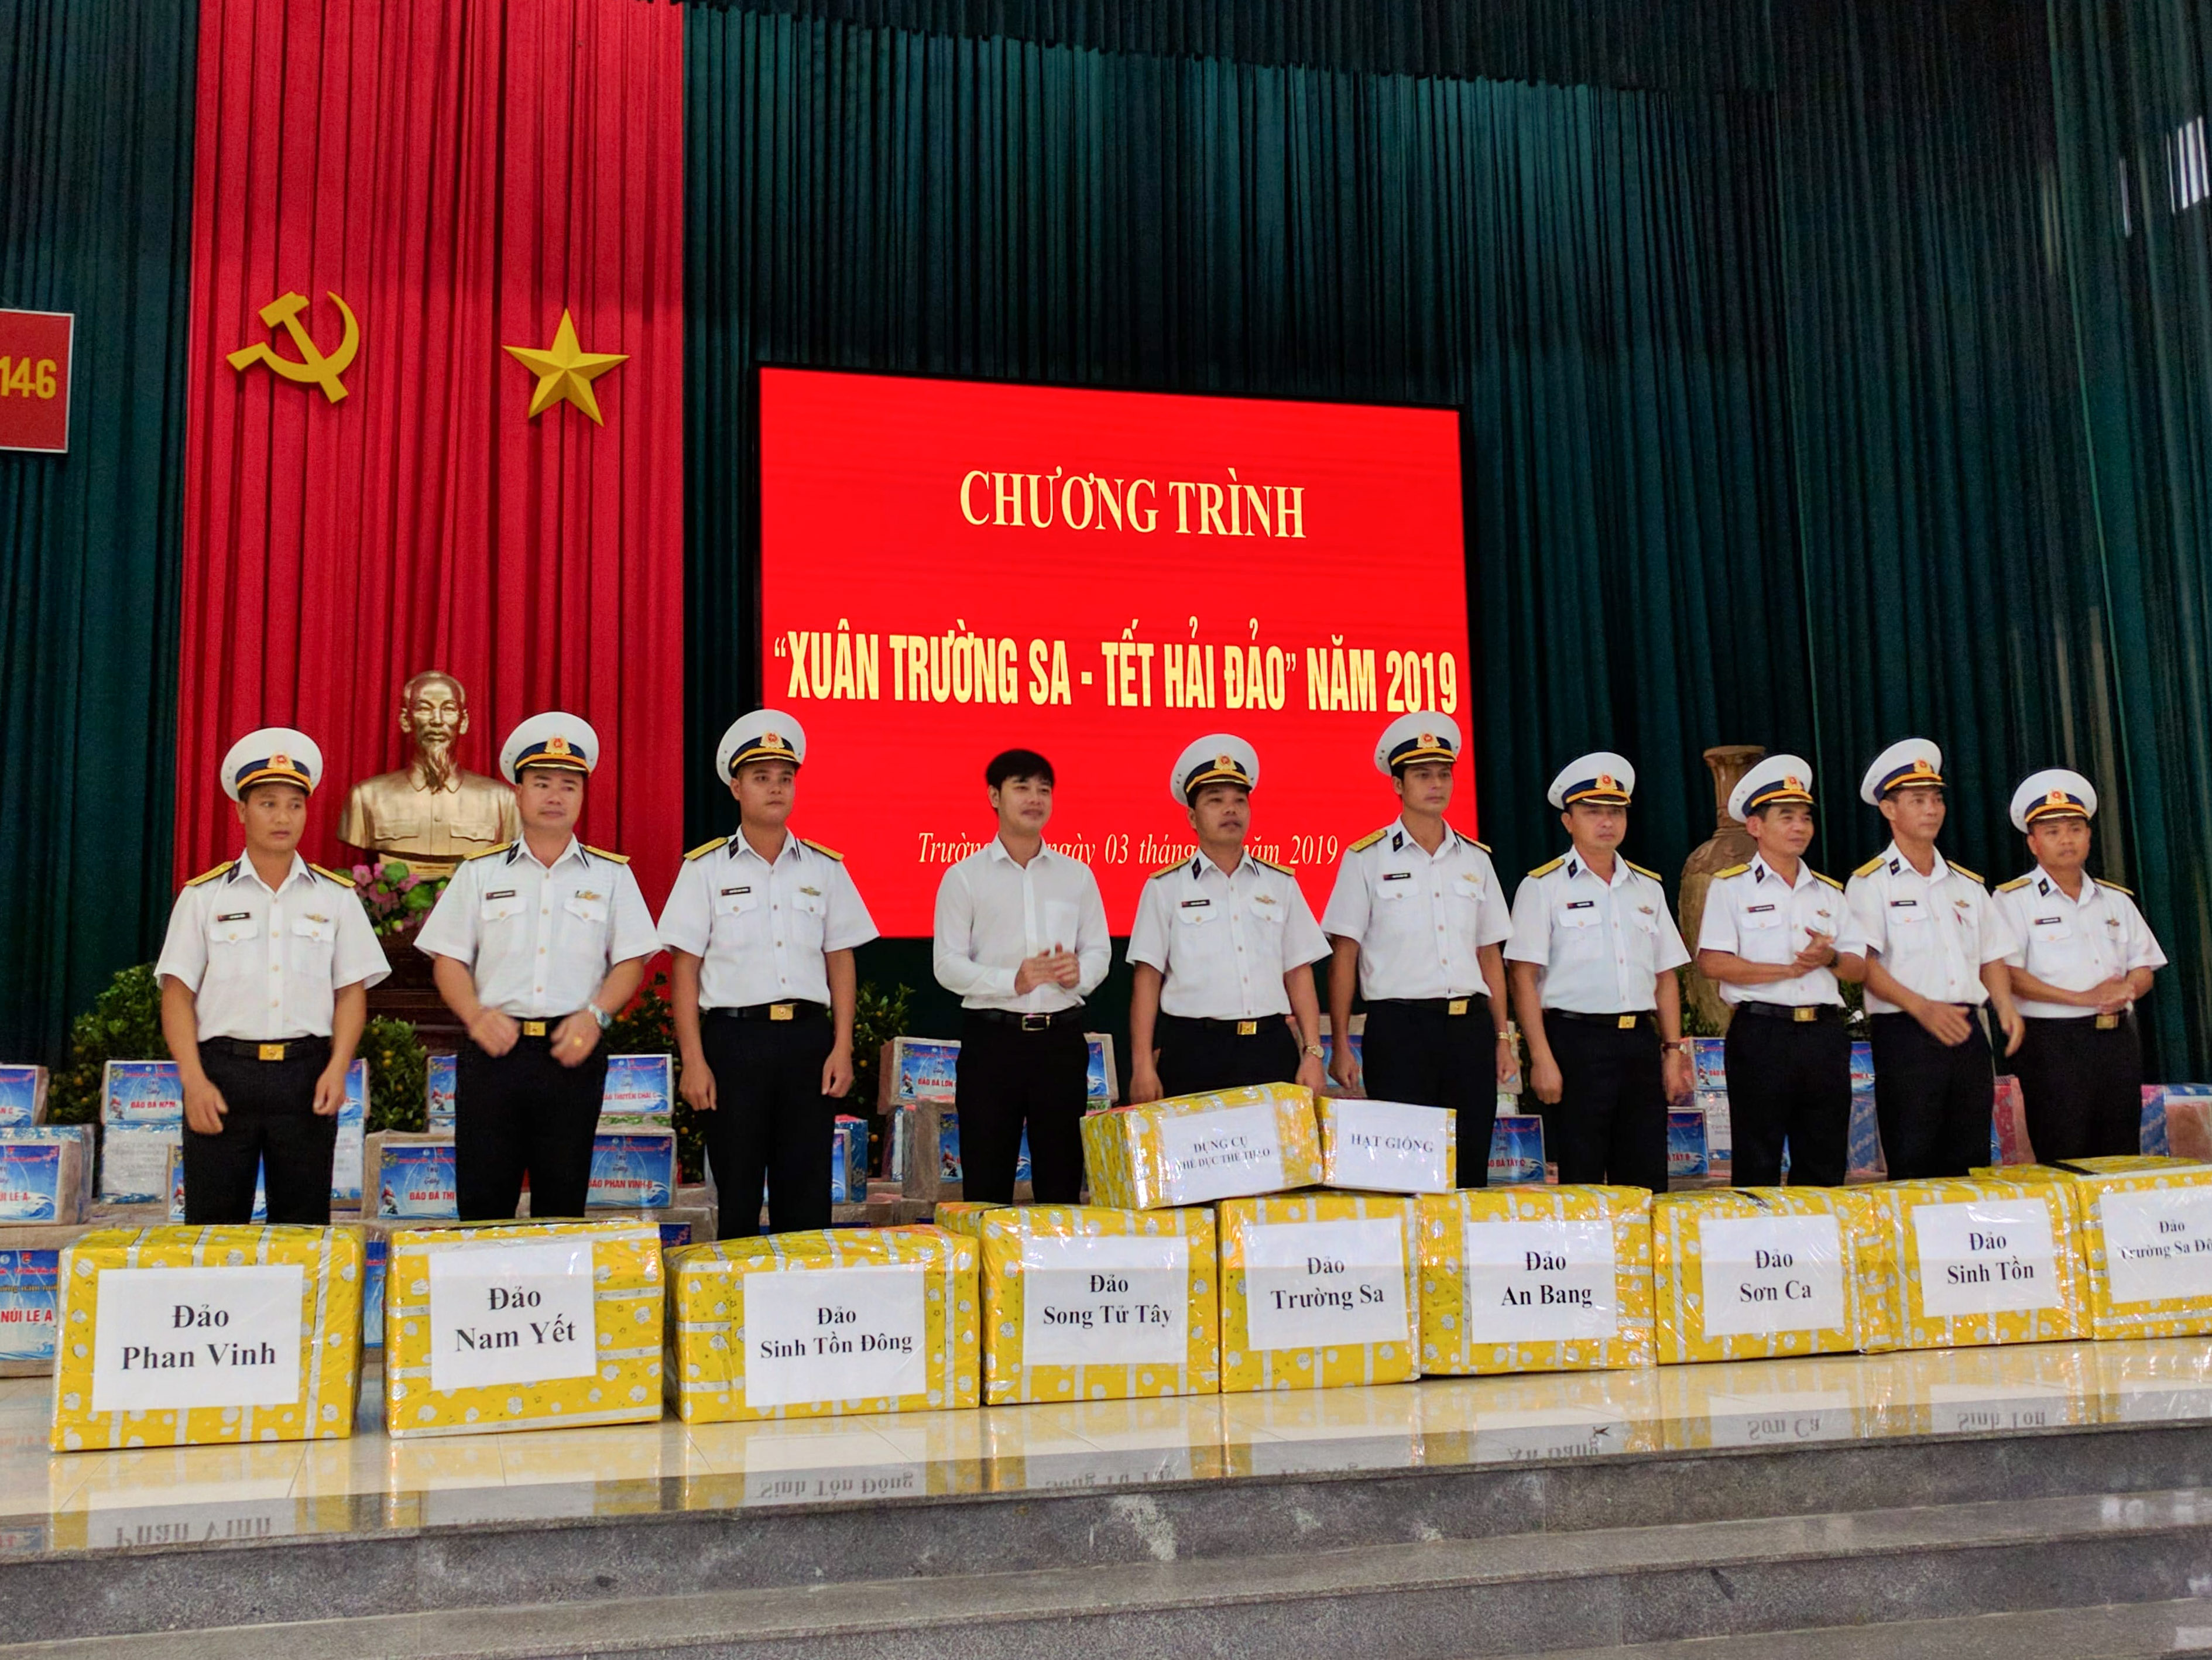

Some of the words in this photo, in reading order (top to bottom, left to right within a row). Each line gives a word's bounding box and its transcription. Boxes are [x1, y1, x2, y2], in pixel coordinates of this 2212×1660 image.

[0, 355, 57, 399] 146
[960, 466, 1158, 533] CHƯƠNG
[1169, 467, 1306, 538] TRÌNH
[889, 619, 1018, 704] TRƯỜNG
[1028, 639, 1072, 706] SA
[1100, 618, 1154, 707] TẾT
[1163, 616, 1215, 709] HẢI
[1306, 634, 1377, 712] NĂM
[1385, 650, 1457, 714] 2019
[918, 832, 993, 863] Trườn
[1105, 834, 1129, 865] 03
[1290, 835, 1338, 865] 2019
[1351, 1133, 1381, 1149] HẠT
[409, 1189, 426, 1201] ĐẢO
[605, 1179, 626, 1189] PHAN
[2159, 1219, 2185, 1233] Đảo
[1969, 1231, 2007, 1251] Đảo
[2117, 1244, 2172, 1259] Trường
[2174, 1240, 2190, 1254] Sa
[1307, 1256, 1345, 1275] Đảo
[1526, 1251, 1567, 1271] Đảo
[1755, 1249, 1793, 1269] Đảo
[1947, 1264, 1991, 1284] Sinh
[1996, 1255, 2035, 1281] Tồn
[1090, 1273, 1129, 1293] Đảo
[1740, 1283, 1778, 1303] Sơn
[1785, 1280, 1812, 1300] Ca
[487, 1285, 542, 1311] Đảo
[1270, 1287, 1354, 1311] Trường
[1359, 1284, 1384, 1304] Sa
[1501, 1285, 1532, 1306] An
[1539, 1284, 1593, 1309] Bang
[1, 1307, 22, 1323] NÚI
[26, 1309, 40, 1323] LE
[44, 1309, 53, 1322] A
[172, 1304, 229, 1329] Đảo
[818, 1306, 857, 1326] Đảo
[1043, 1306, 1094, 1329] Song
[1100, 1304, 1130, 1324] Tử
[1137, 1304, 1172, 1329] Tây
[455, 1327, 519, 1352] Nam
[529, 1313, 575, 1345] Yết
[760, 1339, 806, 1359] Sinh
[812, 1330, 853, 1355] Tồn
[860, 1332, 913, 1354] Đông
[121, 1346, 194, 1370] Phan
[207, 1342, 276, 1367] Vinh
